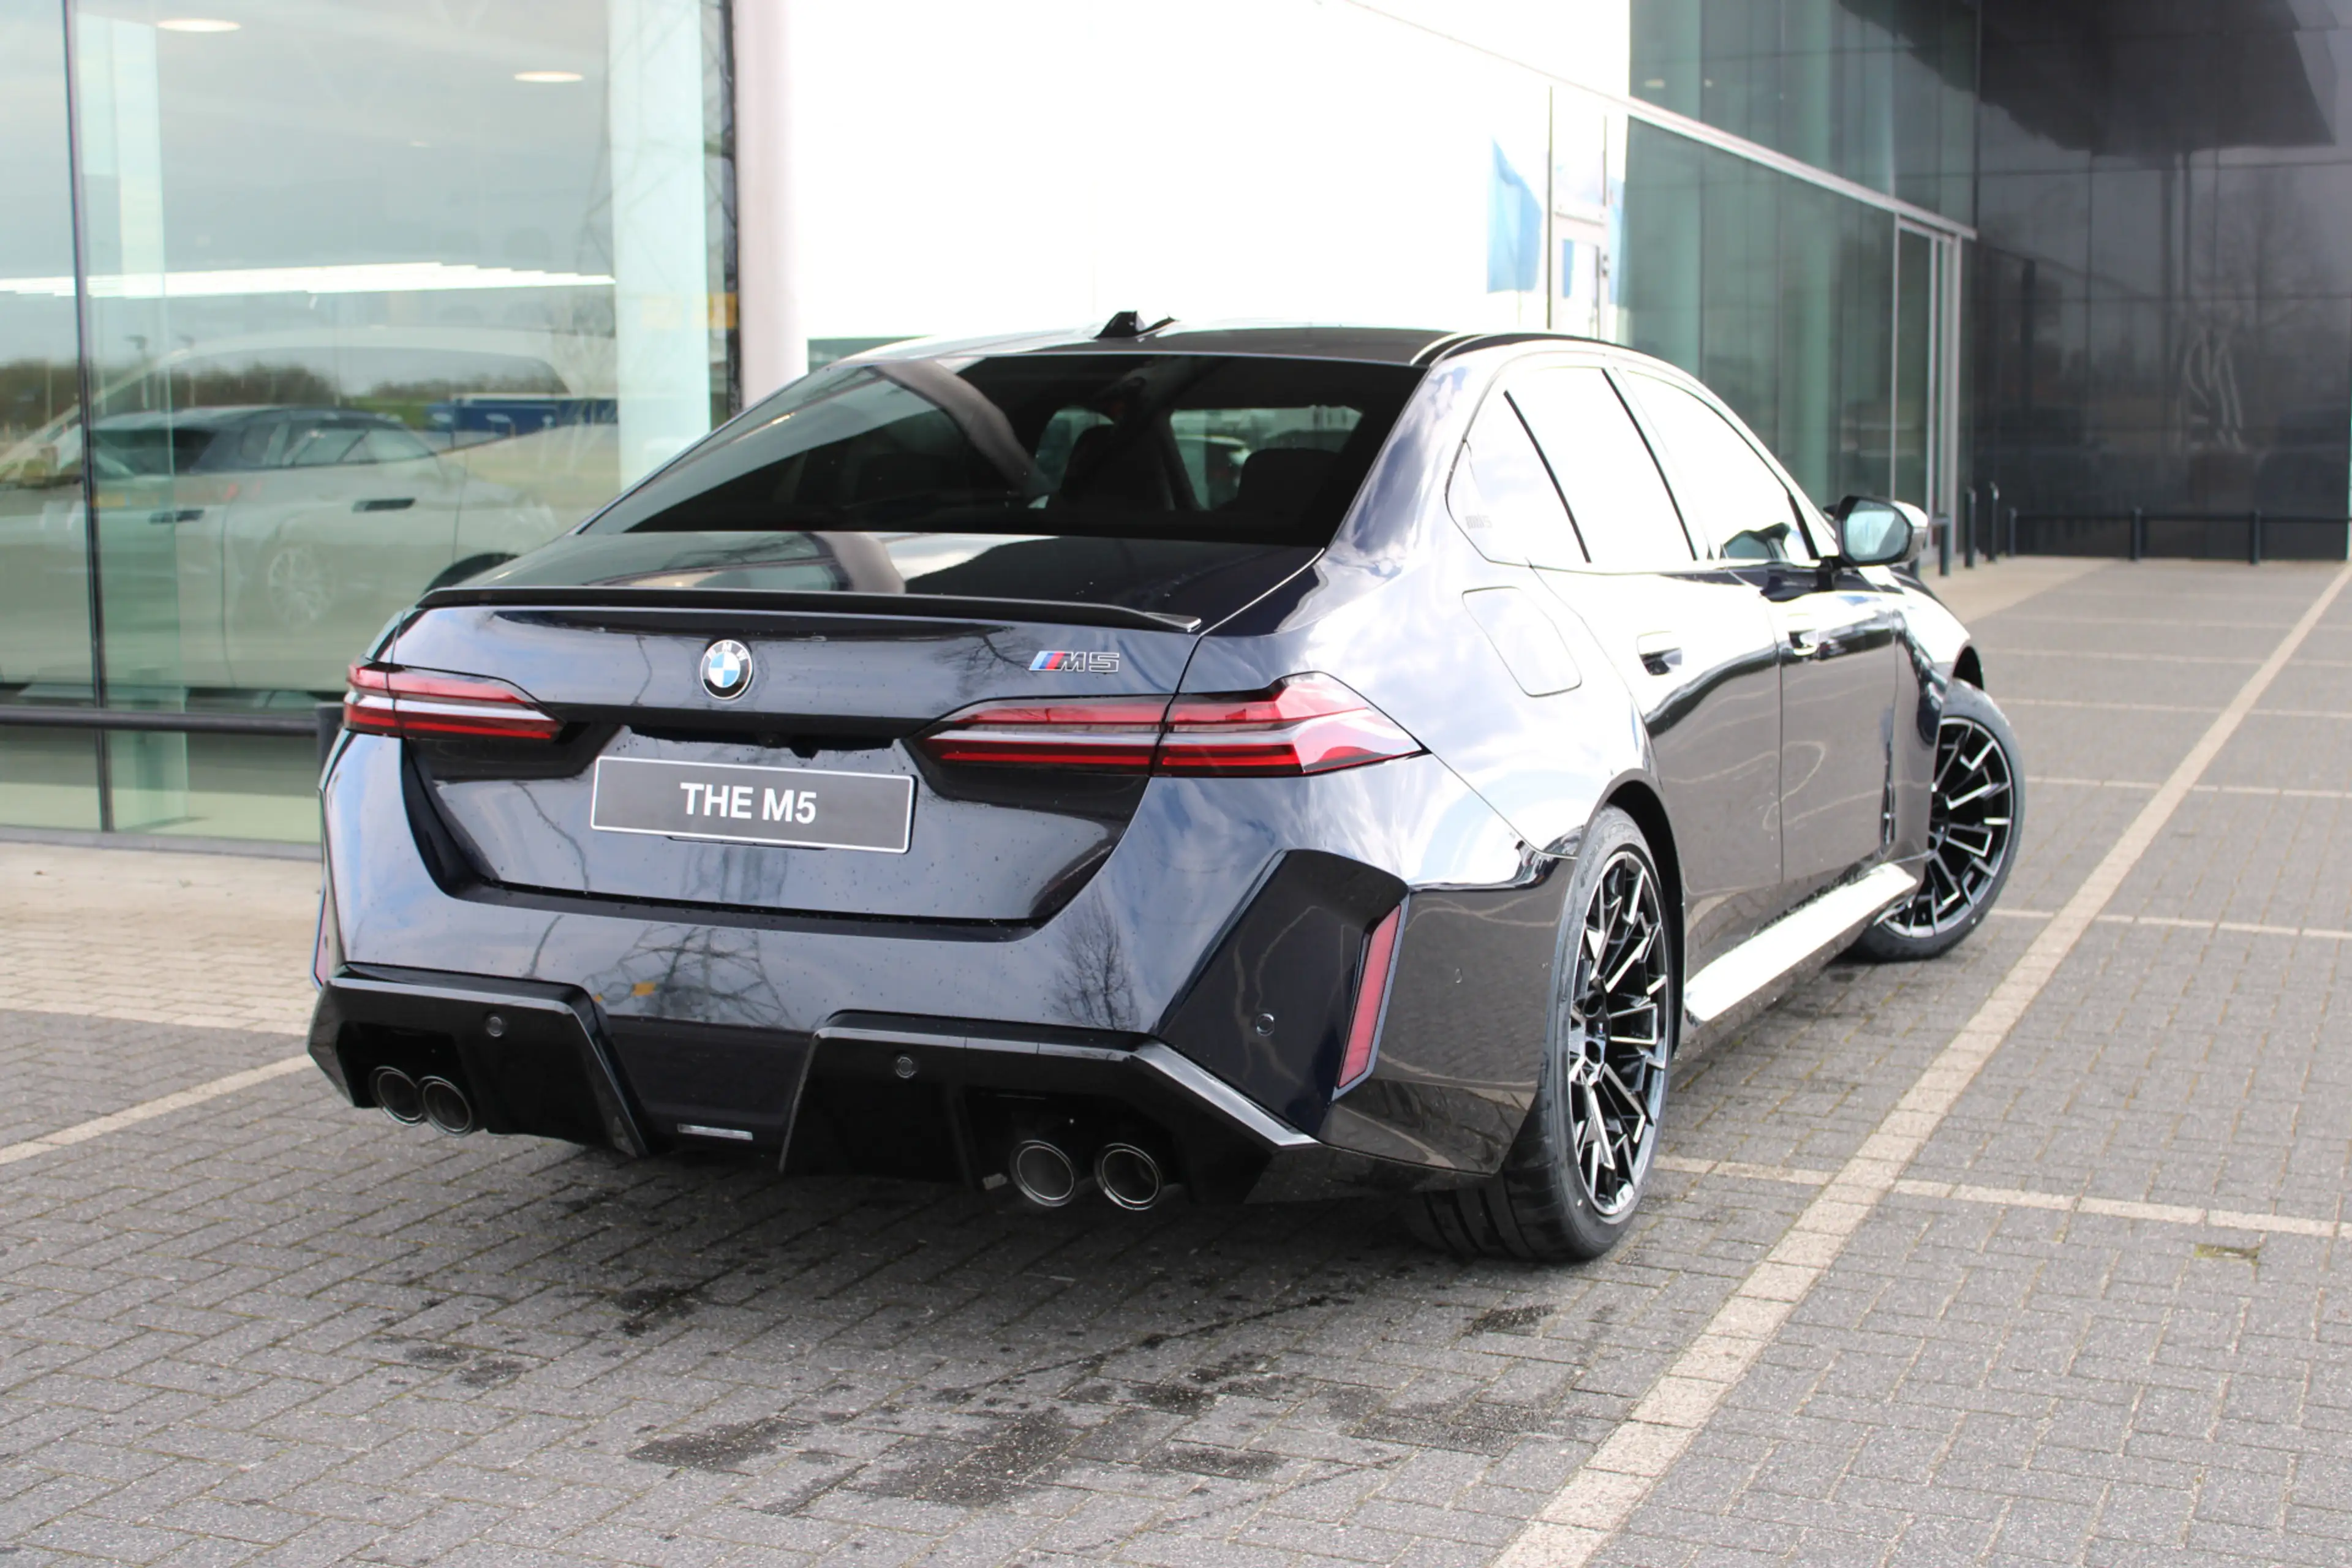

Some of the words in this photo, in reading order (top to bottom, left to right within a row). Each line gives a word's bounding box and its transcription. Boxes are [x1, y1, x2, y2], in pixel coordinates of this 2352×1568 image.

[1052, 651, 1120, 672] M5
[680, 783, 753, 819] THE
[762, 788, 816, 824] M5
